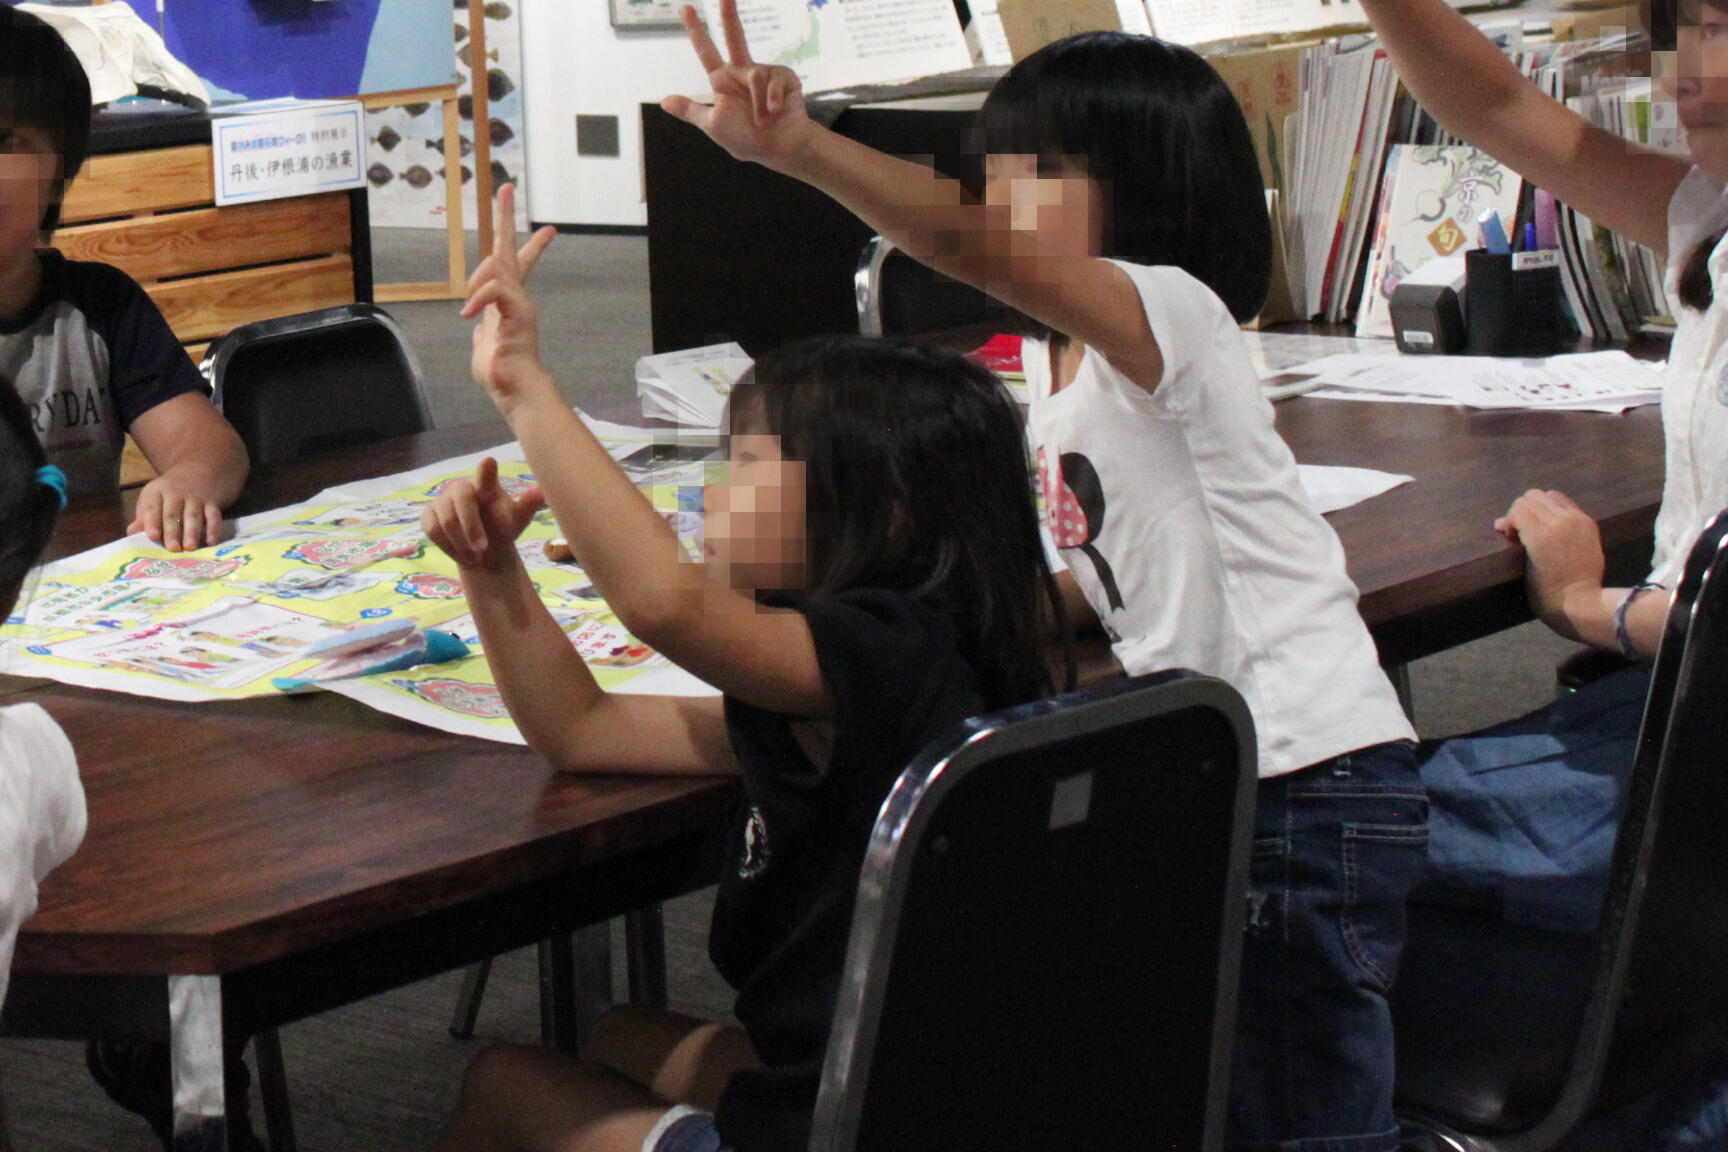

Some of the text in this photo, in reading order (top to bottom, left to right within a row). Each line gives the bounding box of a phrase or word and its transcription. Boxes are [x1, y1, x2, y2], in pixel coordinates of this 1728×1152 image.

[231, 150, 354, 183] 丹後・伊根浦の漁業
[31, 388, 105, 432] RYDA
